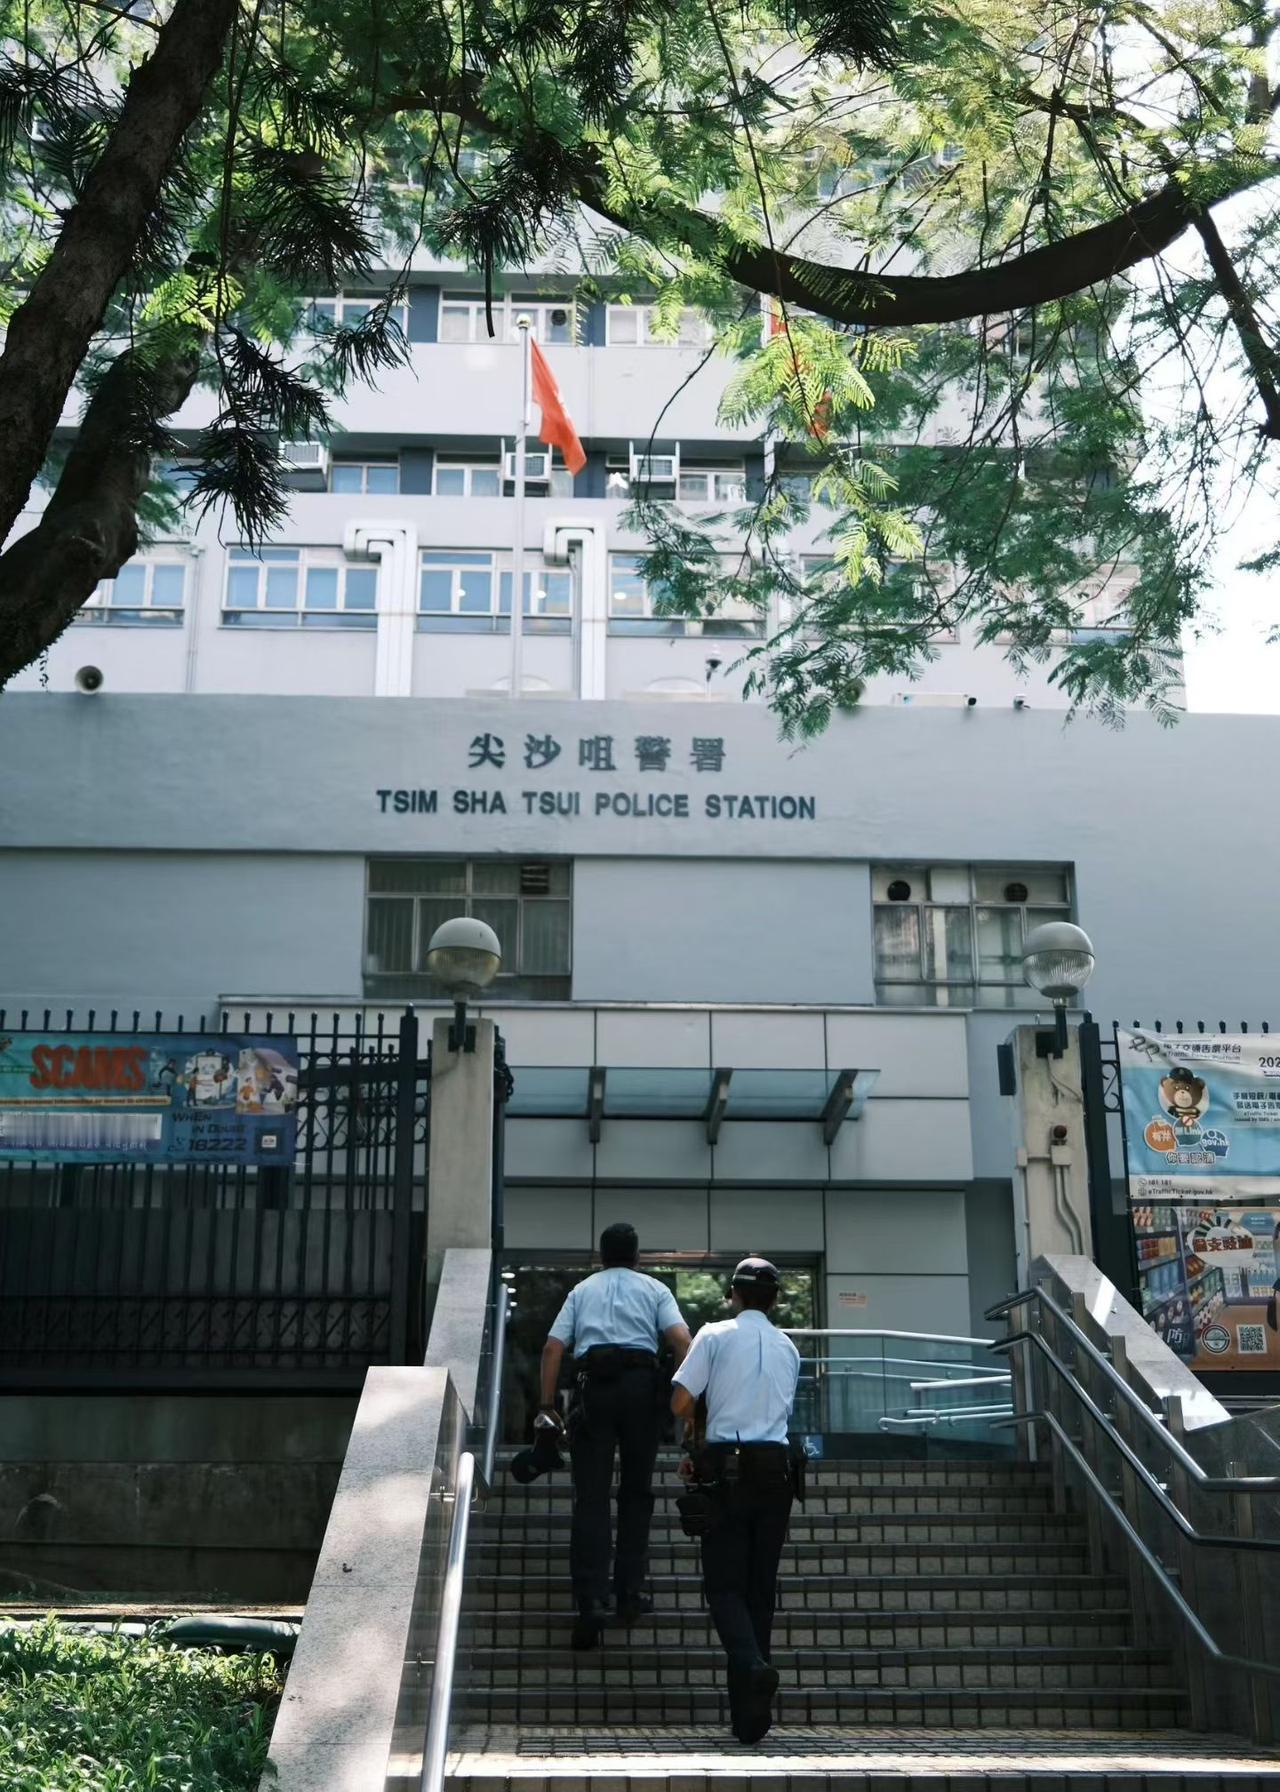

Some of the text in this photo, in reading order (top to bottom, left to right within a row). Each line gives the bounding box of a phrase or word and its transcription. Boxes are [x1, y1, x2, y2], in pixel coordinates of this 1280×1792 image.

[468, 732, 726, 772] 尖沙咀警署
[376, 789, 816, 820] TSIM SHA TSUI POLICE STATION
[30, 1044, 148, 1090] SCAMS
[172, 1111, 211, 1122] WHEN
[192, 1124, 205, 1133] IN
[188, 1137, 247, 1151] 18222
